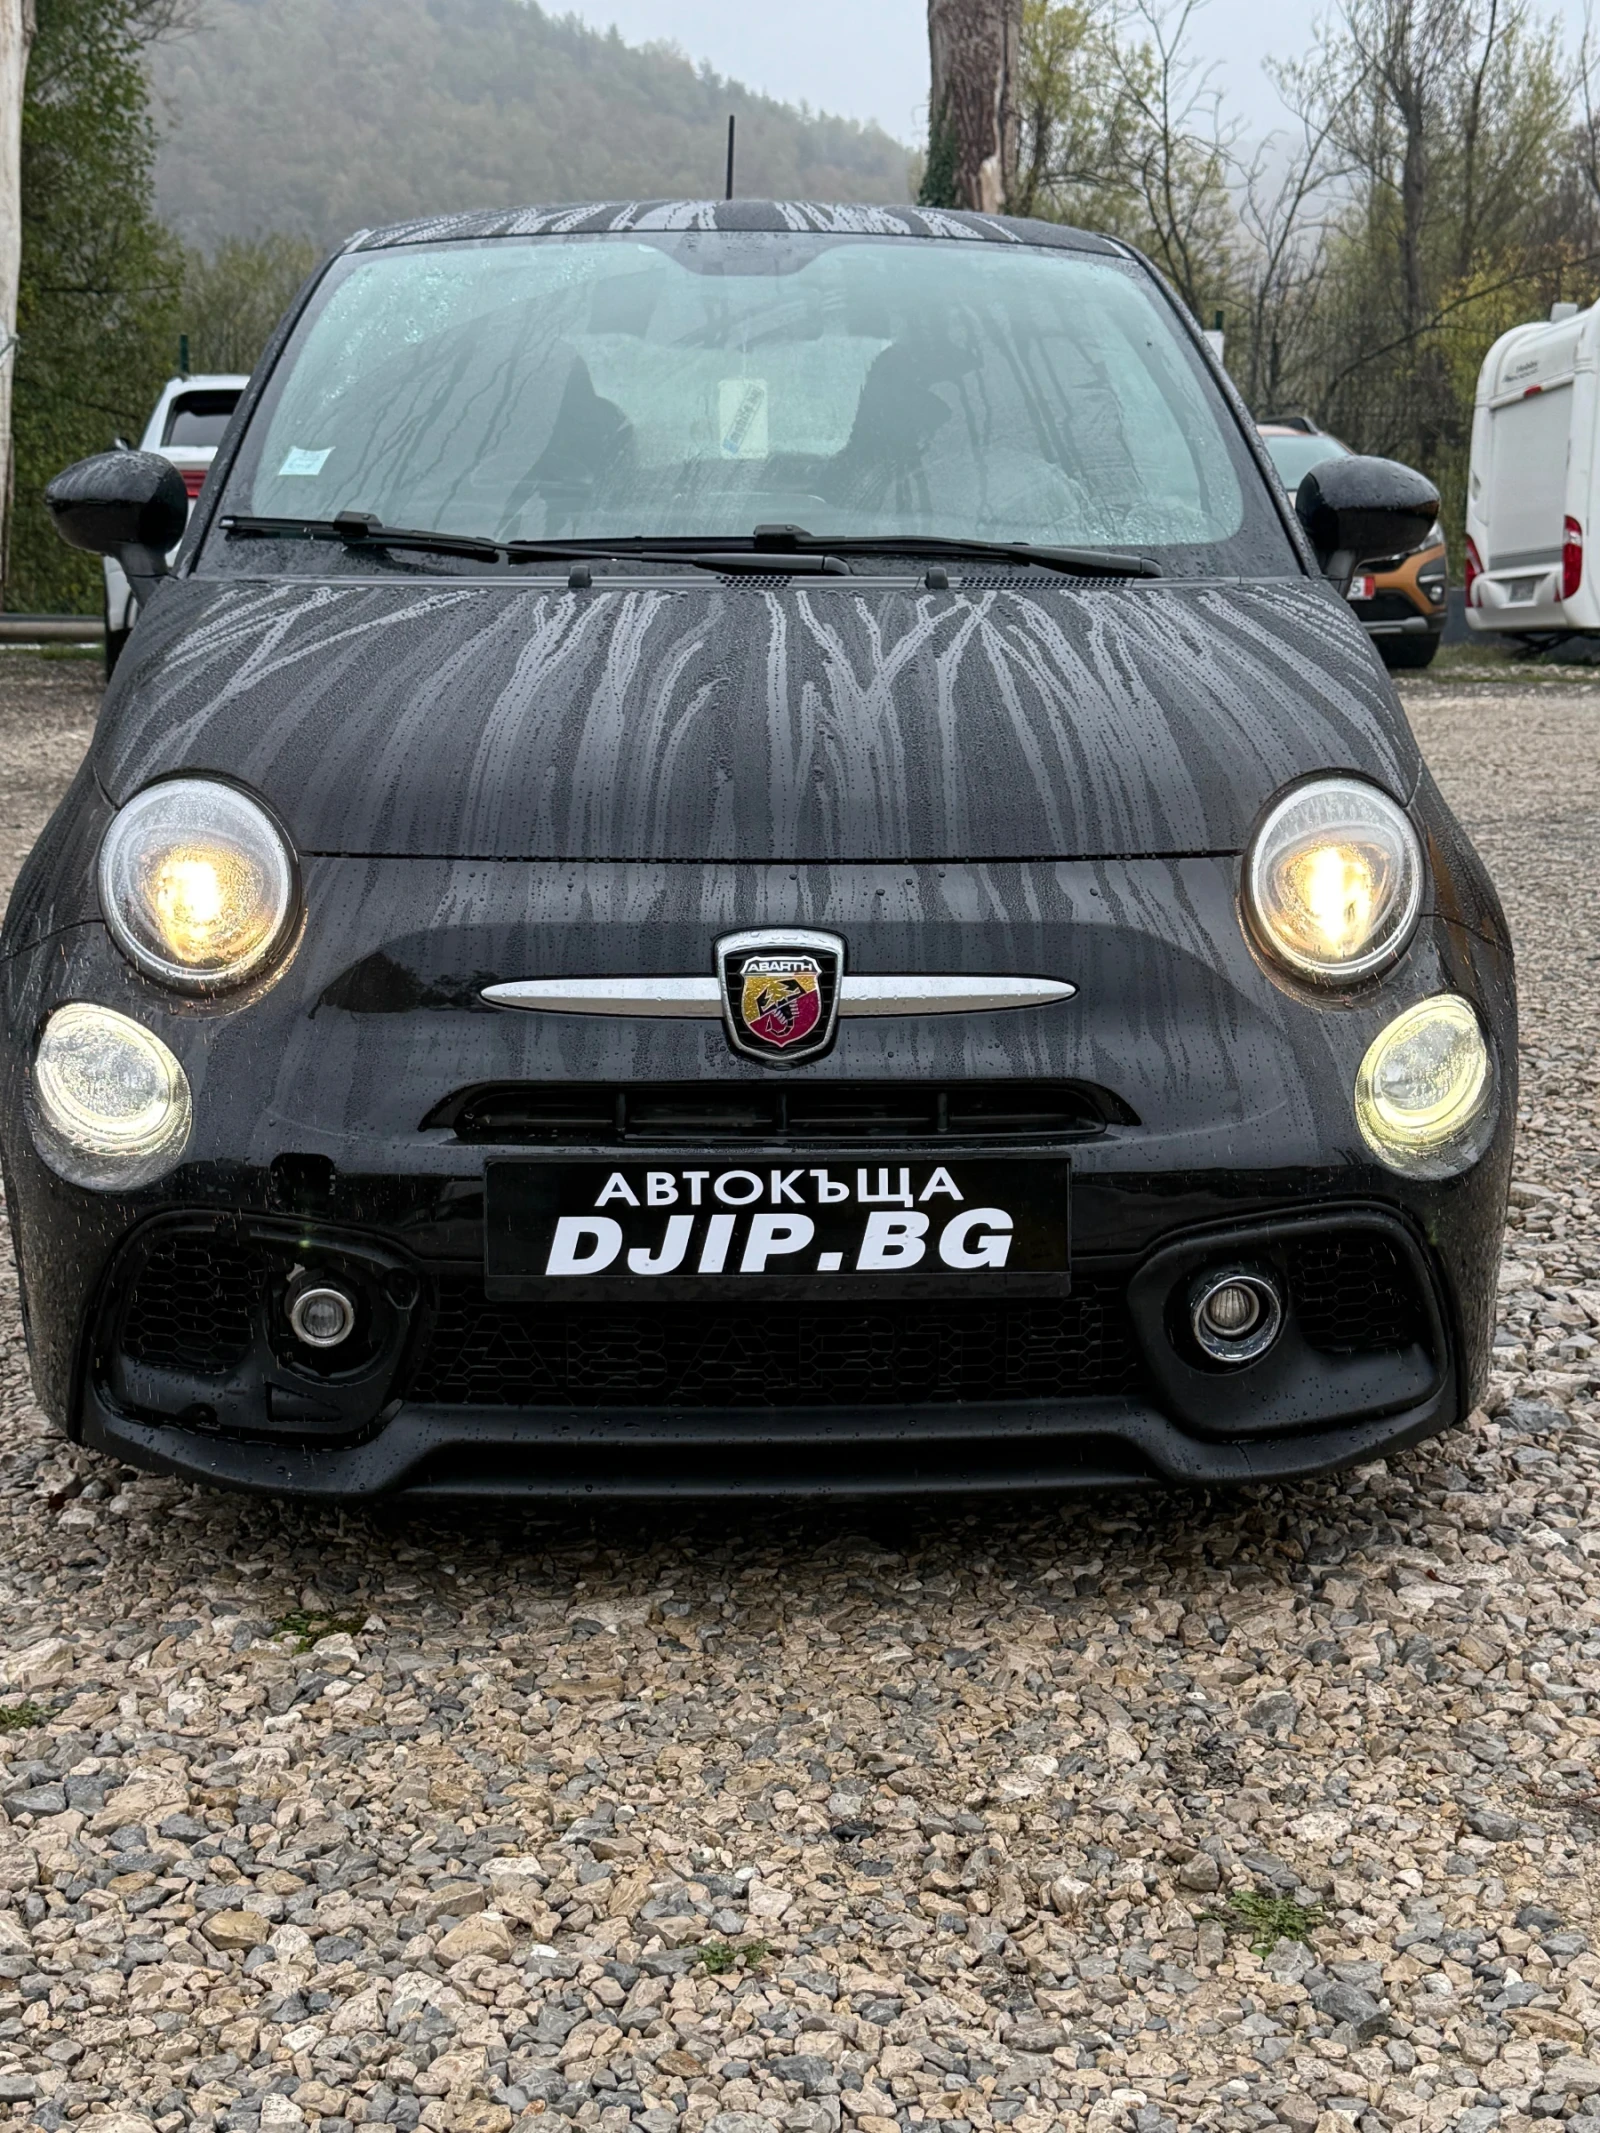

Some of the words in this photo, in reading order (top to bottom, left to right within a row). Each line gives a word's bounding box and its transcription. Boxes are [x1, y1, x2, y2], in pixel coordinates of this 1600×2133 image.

[747, 961, 812, 972] ABARTH
[594, 1166, 965, 1208] АВТОКЪЩА
[545, 1208, 1014, 1276] DJIP.BG
[445, 1305, 1105, 1388] ABARTH
